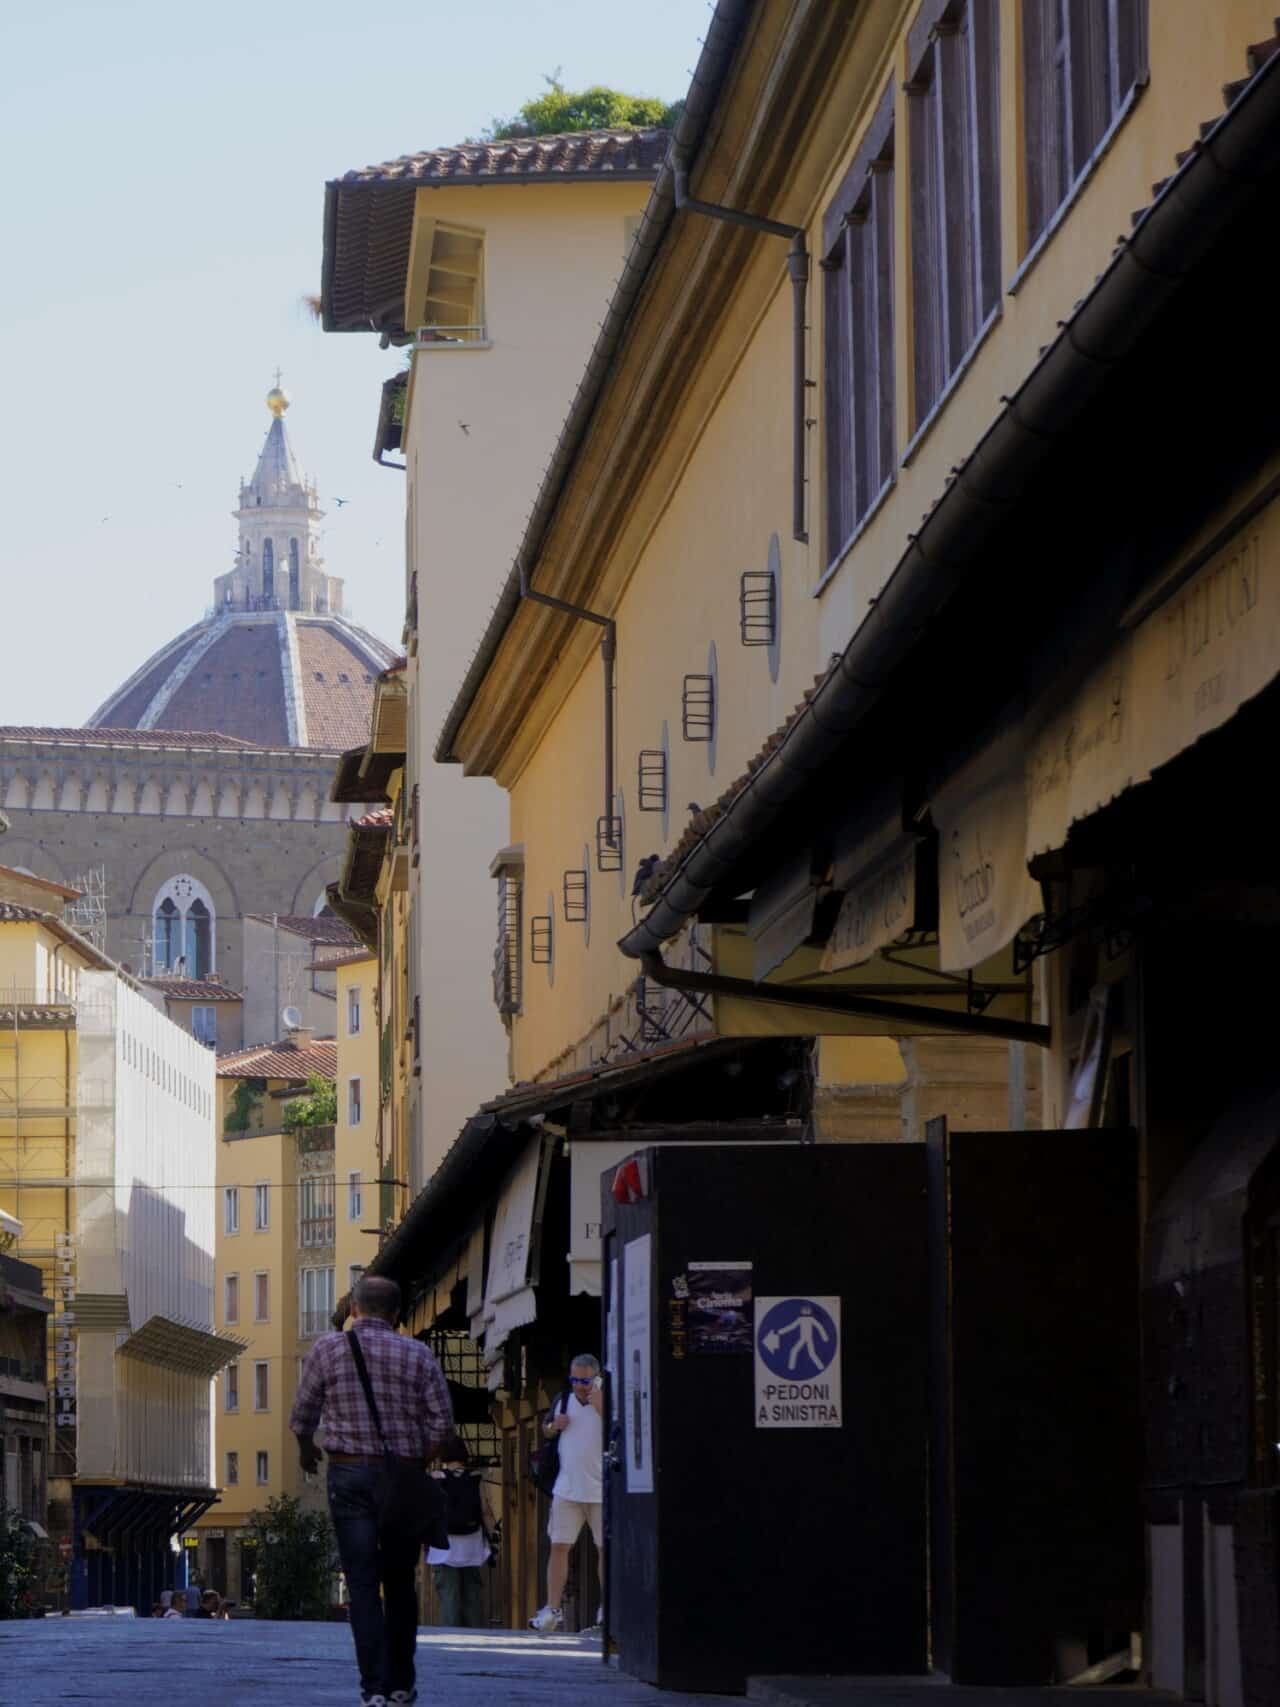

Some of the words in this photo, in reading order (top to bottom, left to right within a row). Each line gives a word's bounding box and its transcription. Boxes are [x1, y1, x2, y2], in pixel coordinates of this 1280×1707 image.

[766, 1384, 830, 1401] PEDONI
[759, 1405, 768, 1422] A
[772, 1405, 839, 1421] SINISTRA
